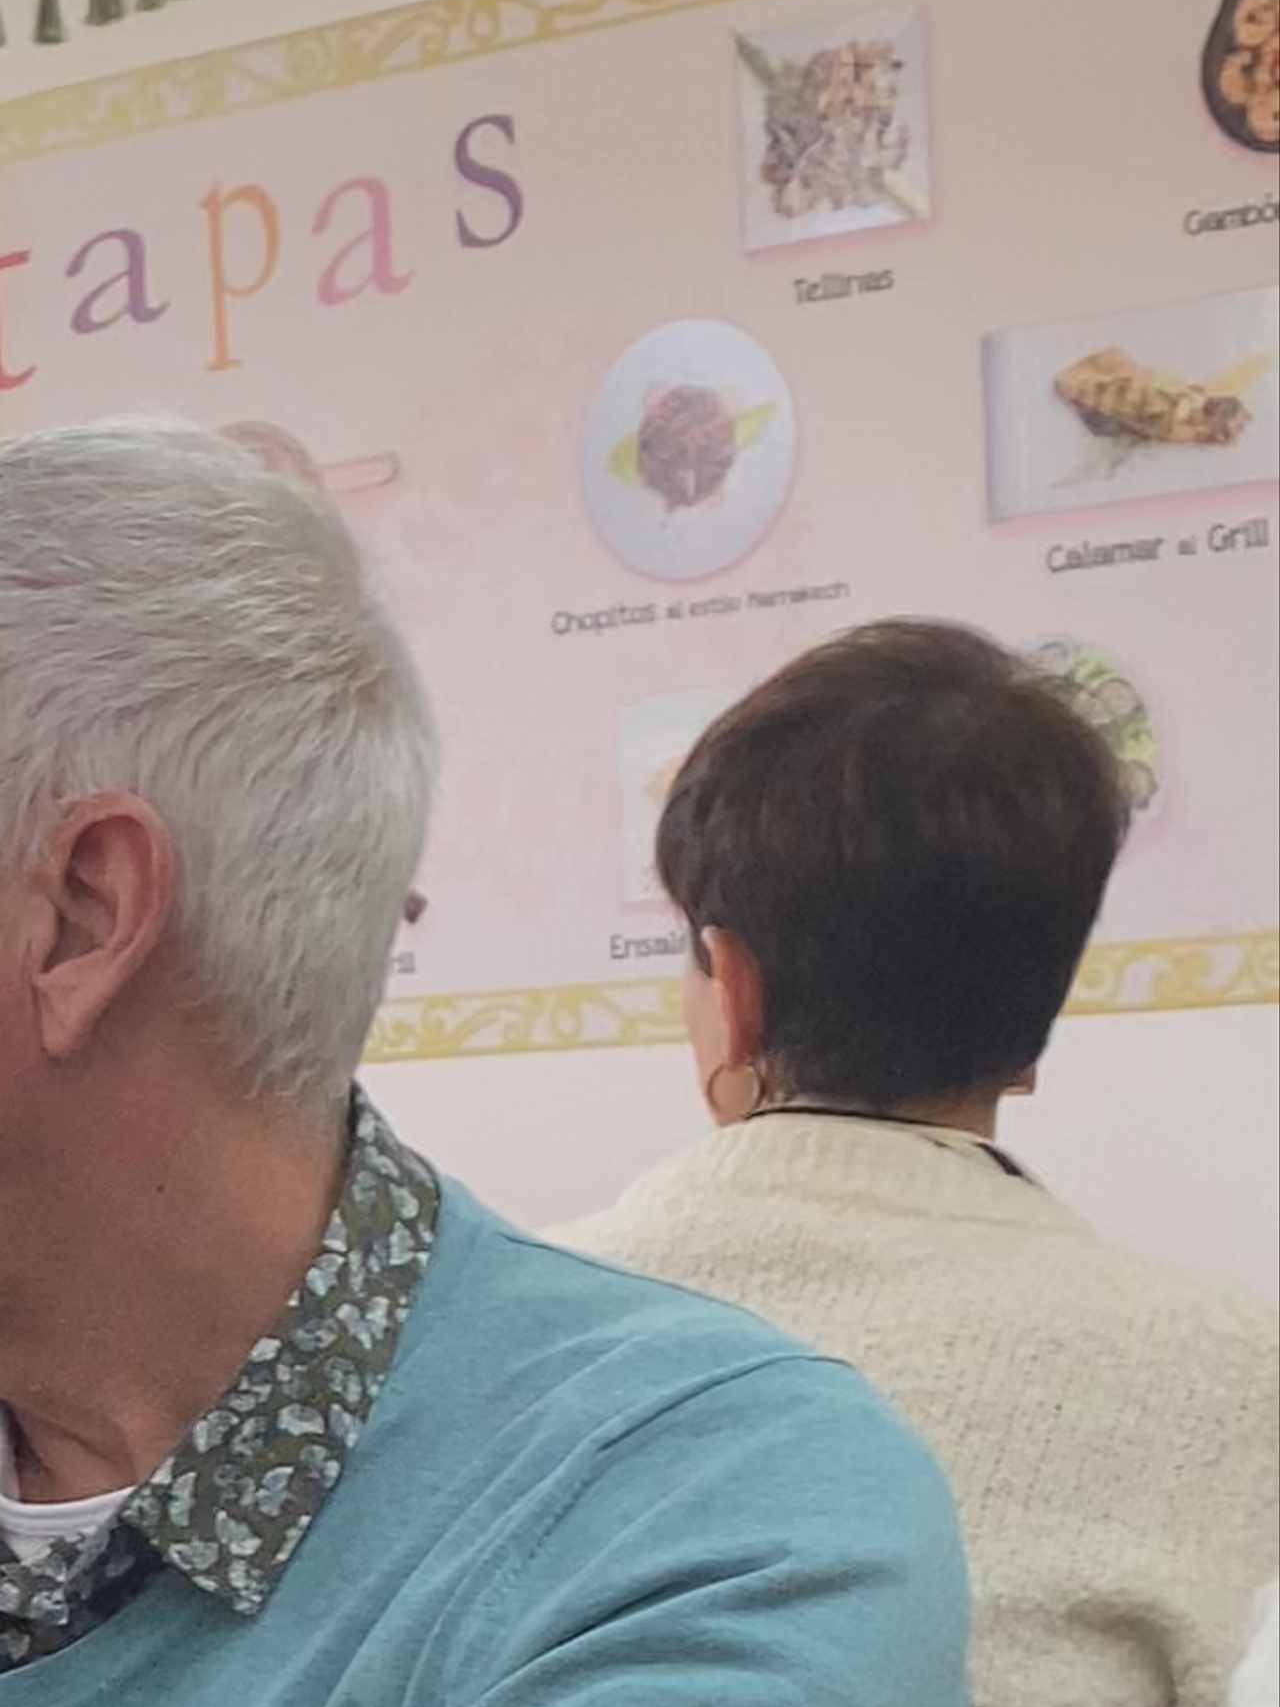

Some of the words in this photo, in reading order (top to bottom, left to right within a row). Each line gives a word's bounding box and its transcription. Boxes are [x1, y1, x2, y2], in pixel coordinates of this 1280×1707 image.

[1046, 537, 1165, 574] Calamar
[1207, 517, 1269, 553] Grill
[551, 603, 656, 637] Chopitos
